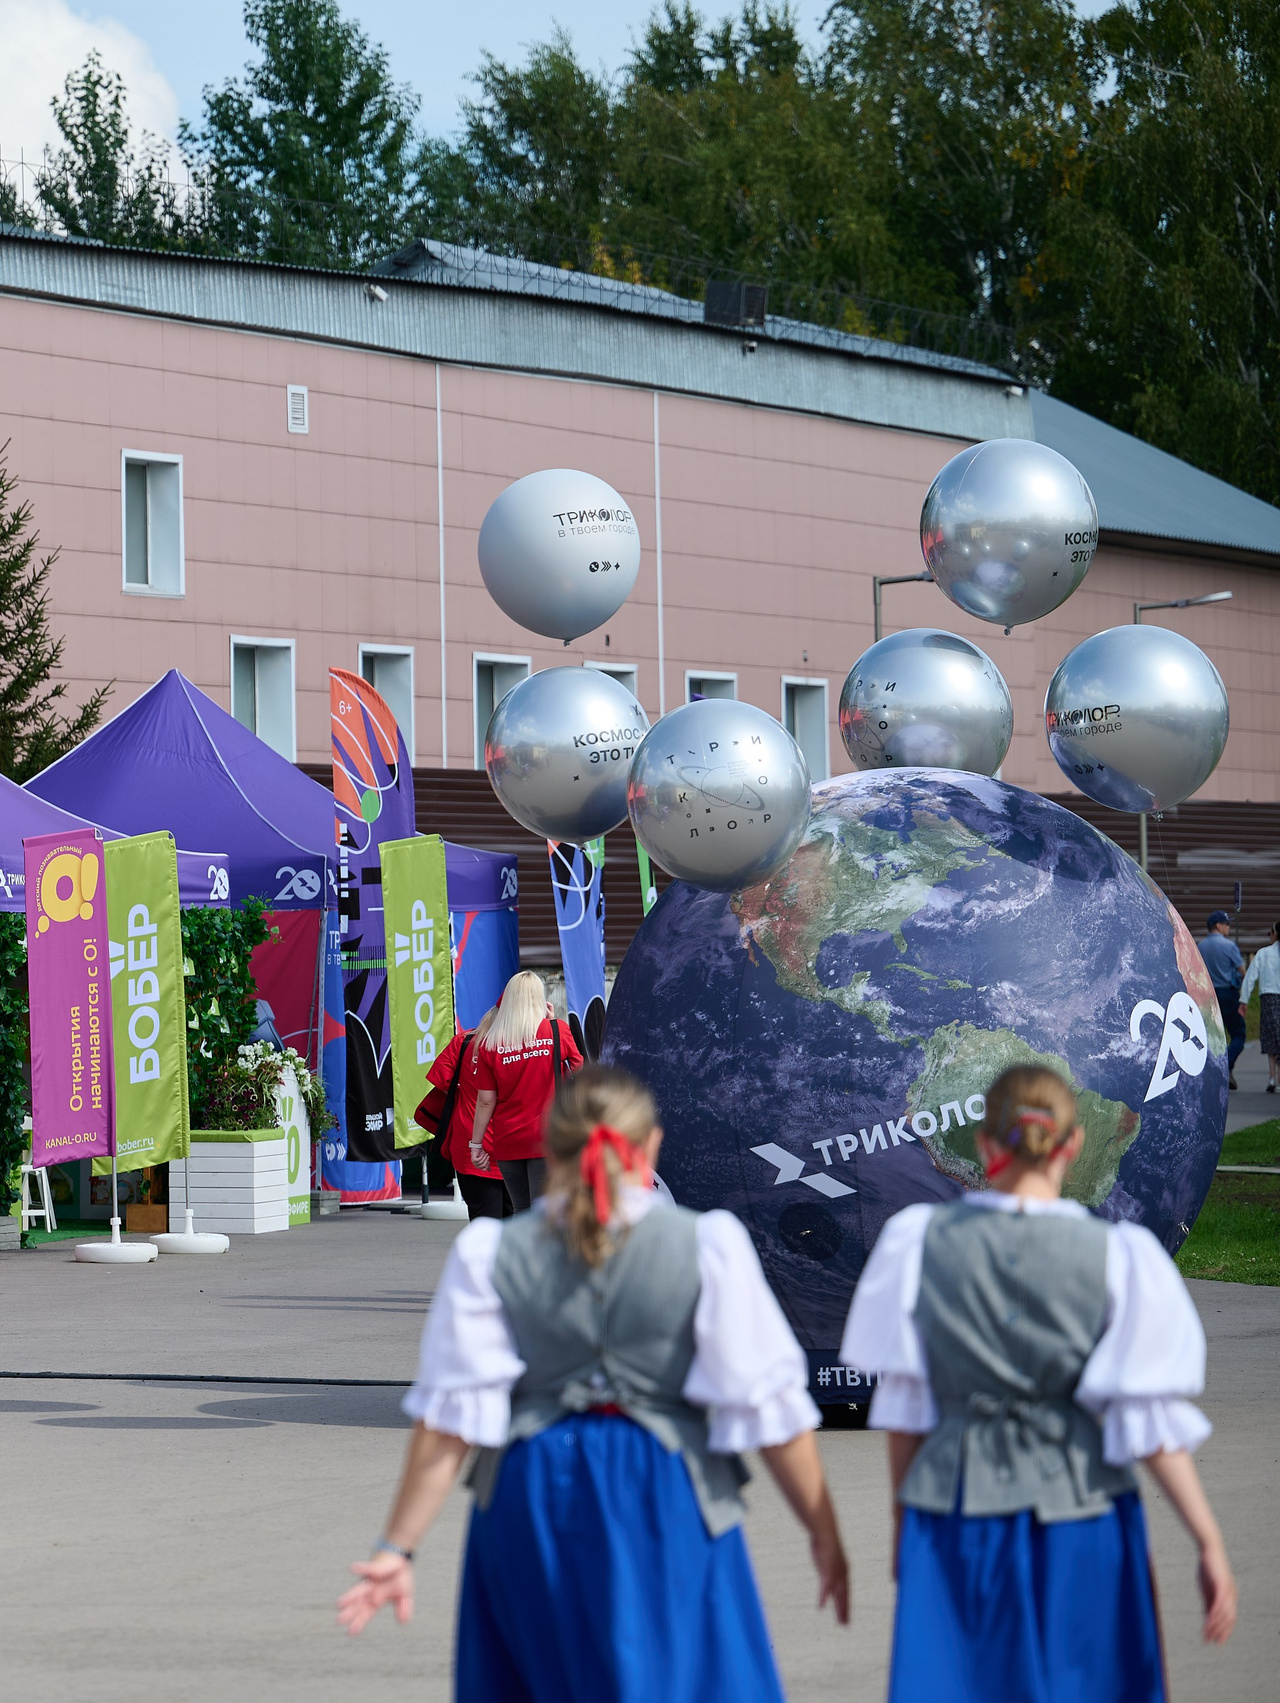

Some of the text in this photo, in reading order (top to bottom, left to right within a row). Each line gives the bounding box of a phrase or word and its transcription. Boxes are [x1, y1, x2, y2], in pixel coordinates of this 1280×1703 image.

[339, 700, 352, 715] 6+
[1079, 721, 1123, 737] городе
[589, 748, 621, 764] ЭТО
[88, 966, 99, 978] с
[88, 982, 103, 1110] начинаются
[1129, 991, 1208, 1103] 20
[69, 1005, 84, 1112] Открытия
[502, 1048, 550, 1065] для всего
[45, 1131, 97, 1150] KANAL-O.RU
[117, 1137, 154, 1152] bober.ru
